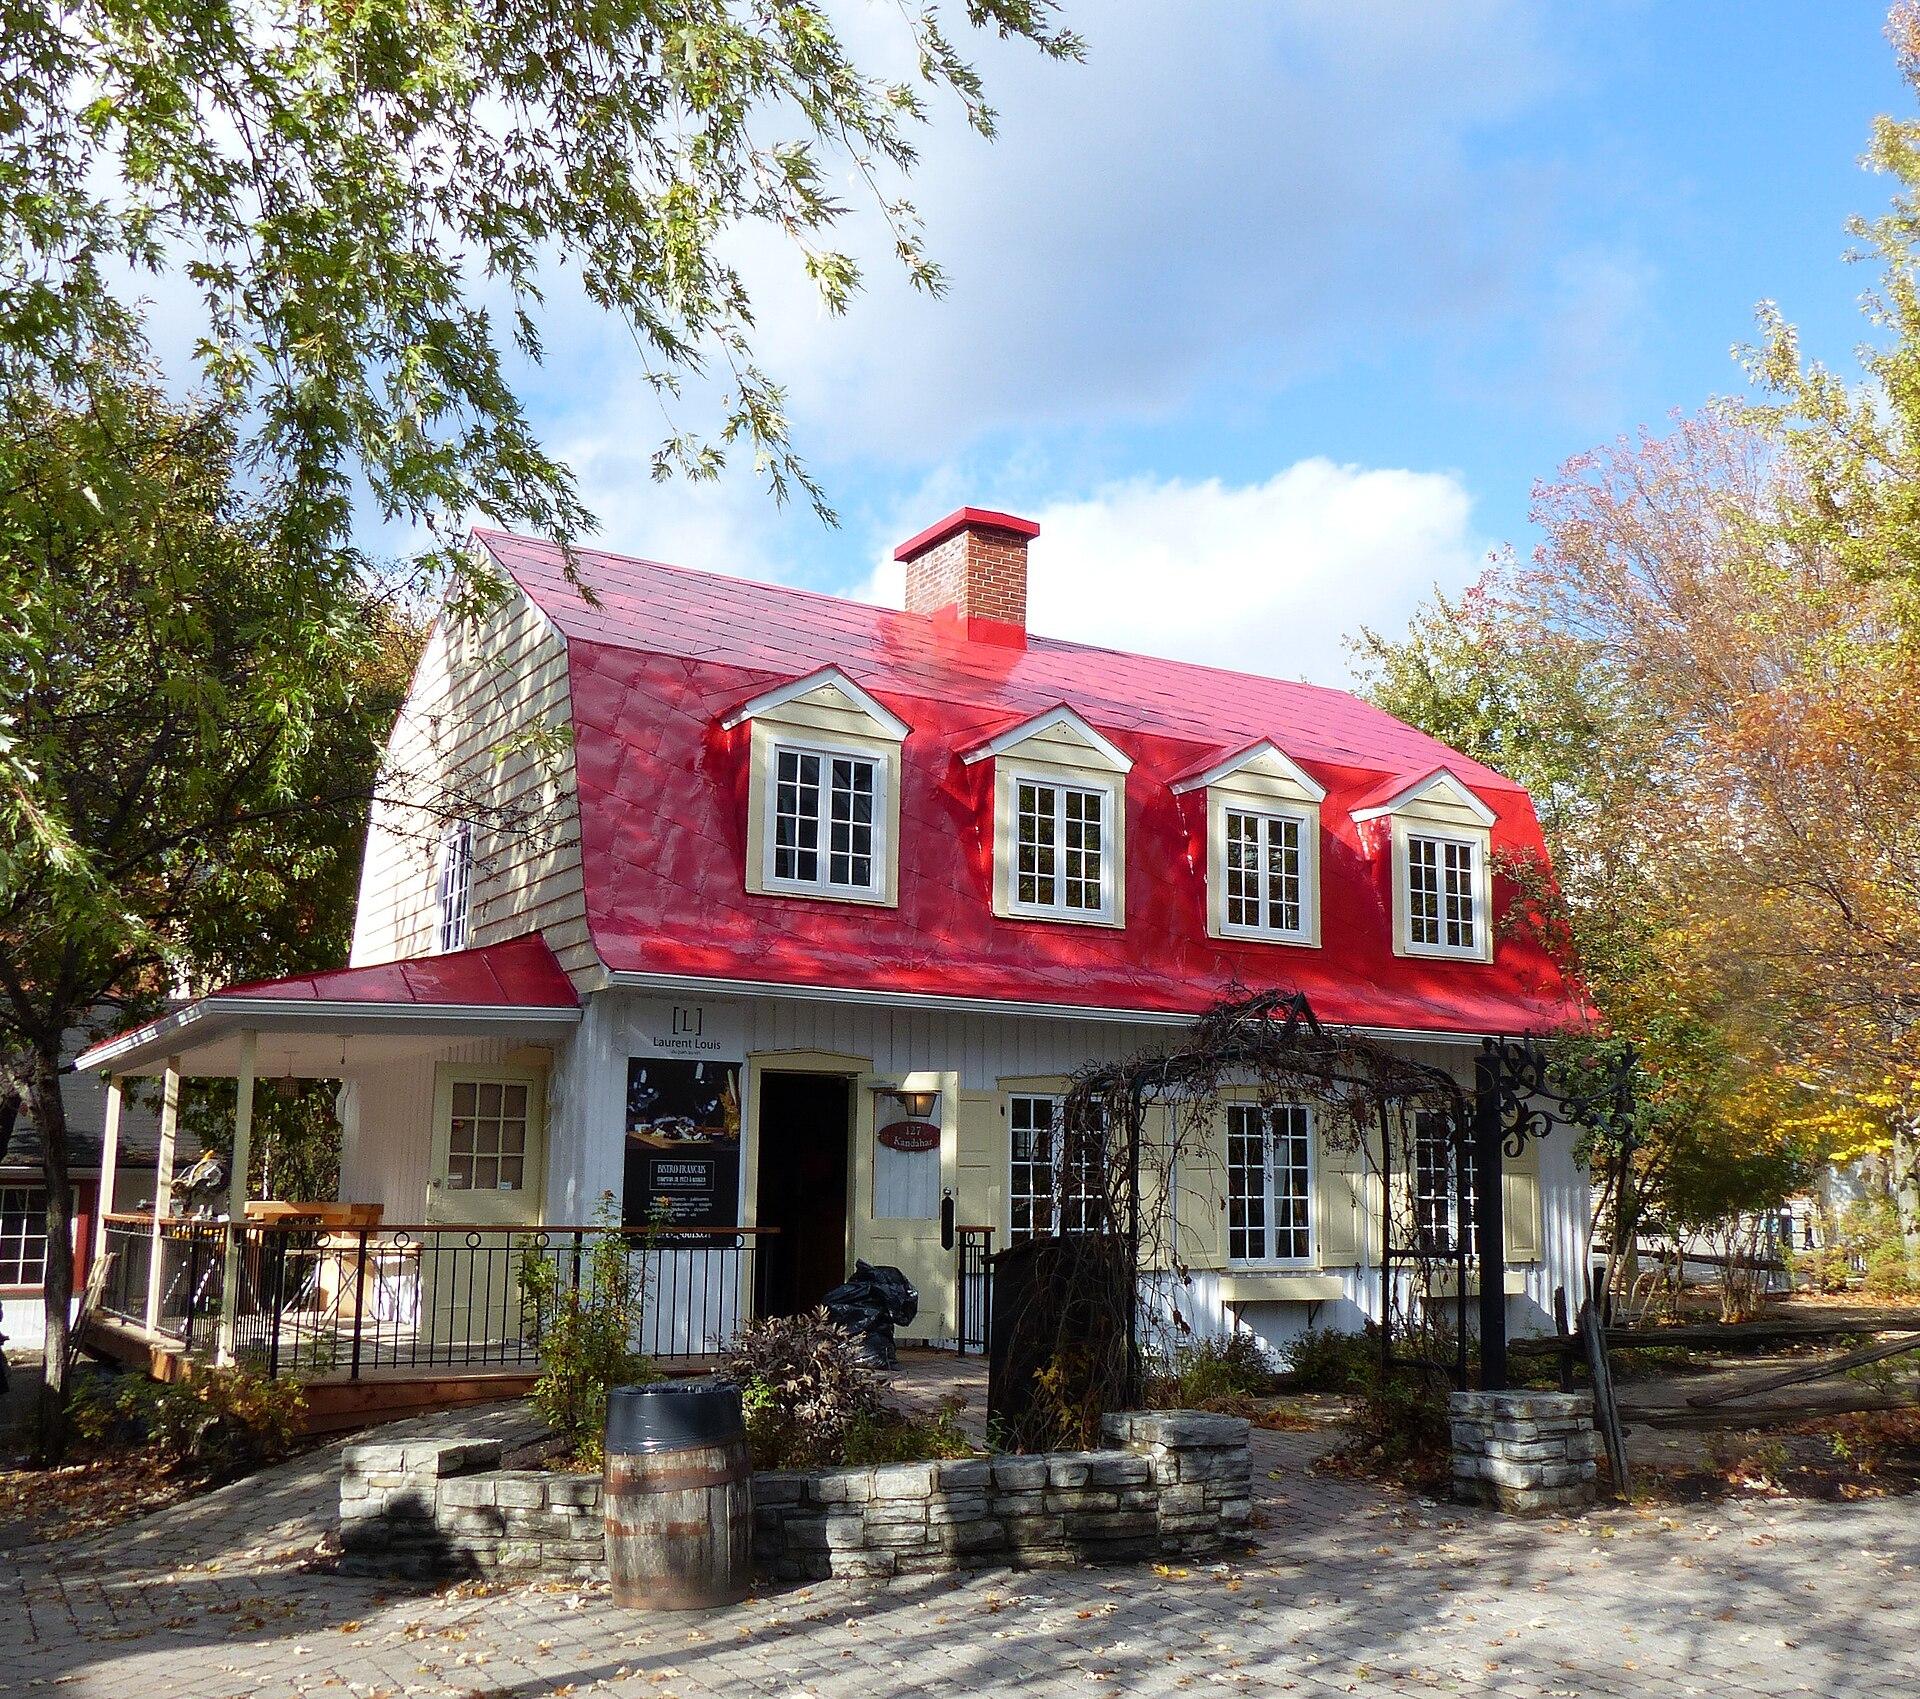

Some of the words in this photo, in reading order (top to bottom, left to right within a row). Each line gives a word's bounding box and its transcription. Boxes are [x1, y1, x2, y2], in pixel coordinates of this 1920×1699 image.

[653, 1037, 691, 1048] Laurent
[694, 1038, 721, 1050] Louis
[905, 1126, 922, 1136] 127
[893, 1135, 934, 1148] Kandahar
